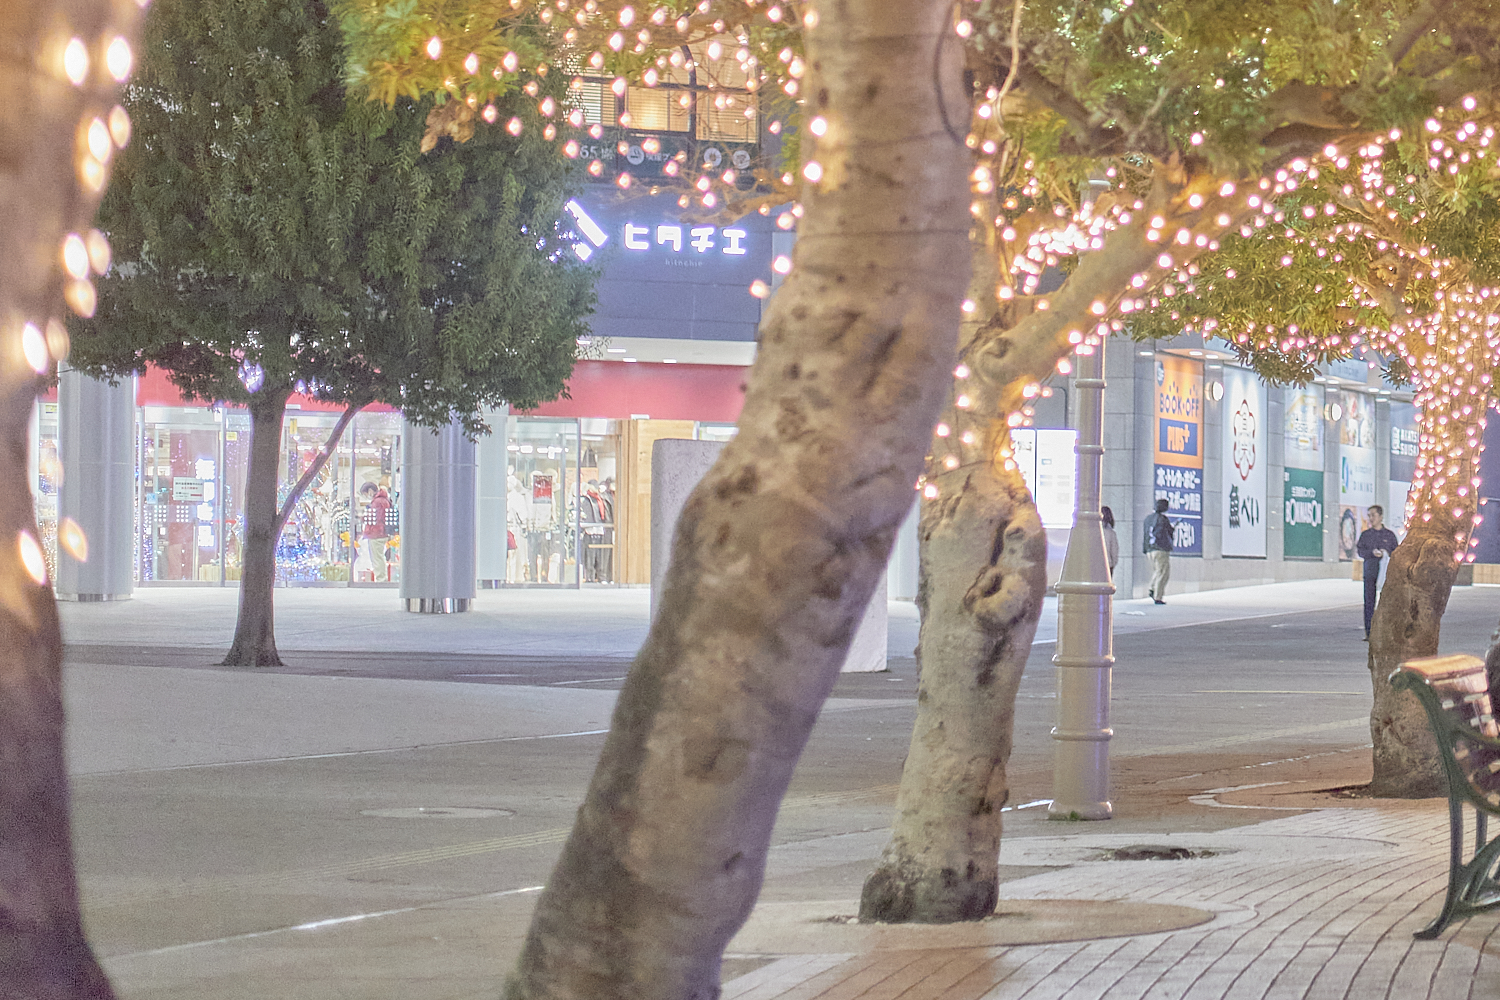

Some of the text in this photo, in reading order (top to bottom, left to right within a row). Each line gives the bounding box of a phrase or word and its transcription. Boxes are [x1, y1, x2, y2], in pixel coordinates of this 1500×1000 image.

[625, 223, 746, 255] ヒタチエ
[1229, 484, 1259, 528] 魚べい
